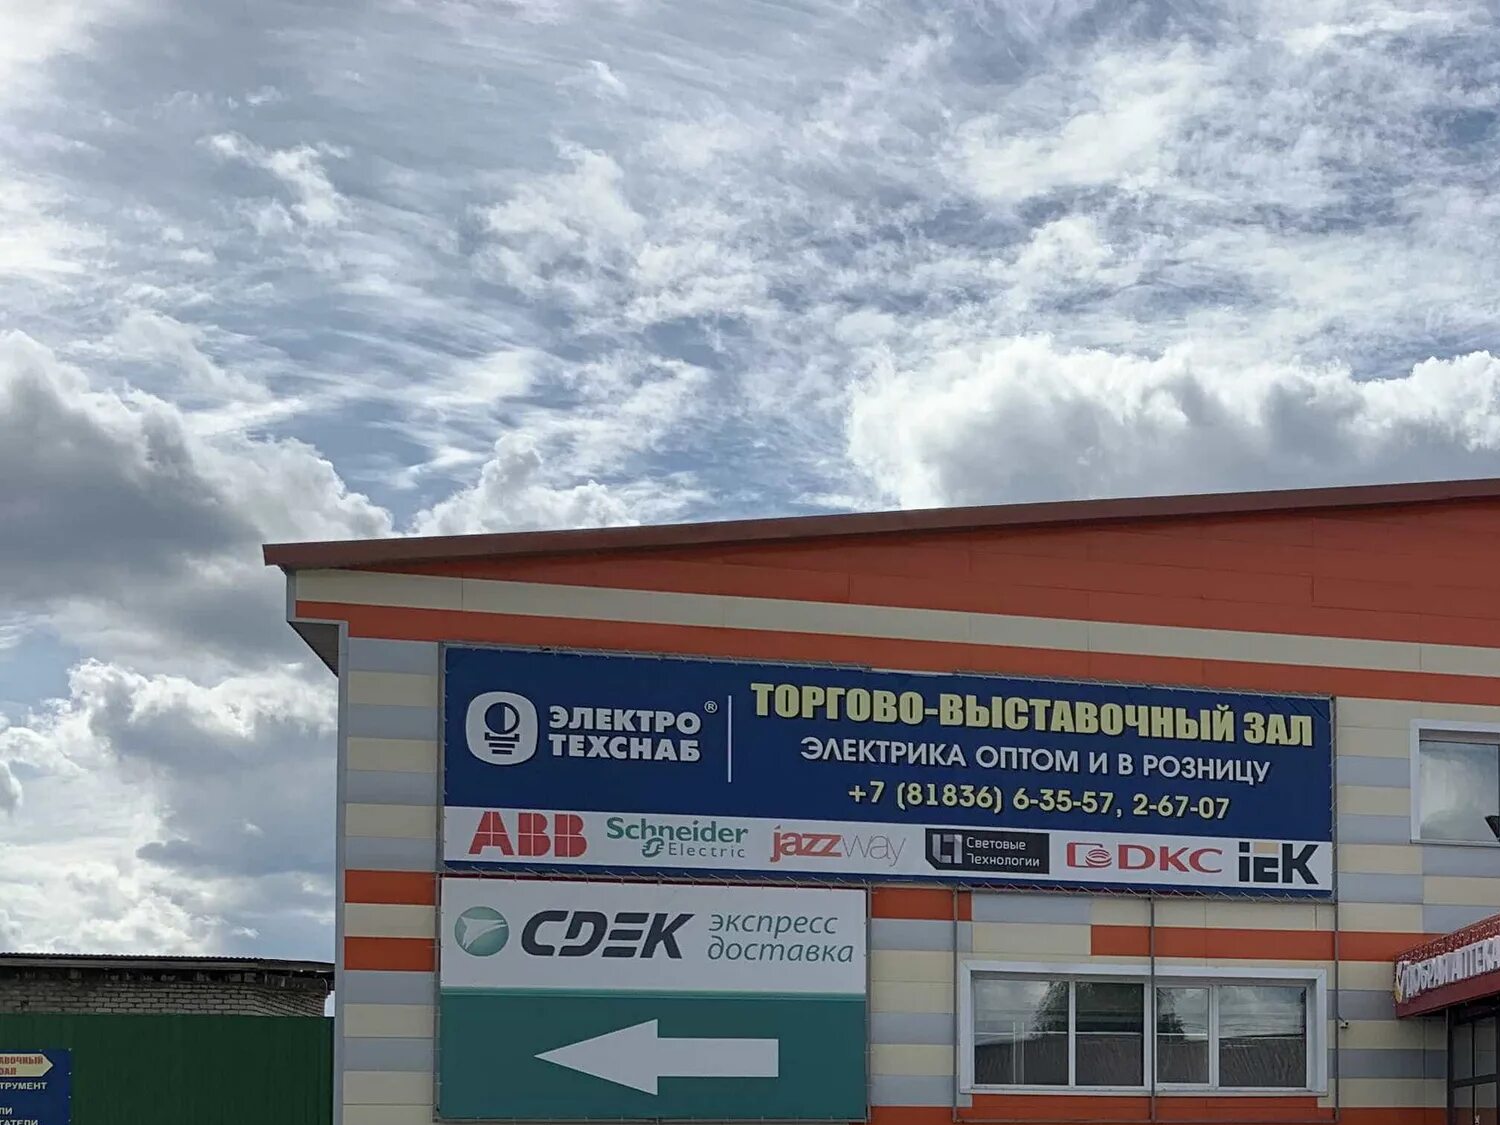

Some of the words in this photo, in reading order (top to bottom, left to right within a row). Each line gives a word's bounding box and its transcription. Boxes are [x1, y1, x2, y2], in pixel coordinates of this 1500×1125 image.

[549, 705, 702, 735] ЭЛЕКТРО
[751, 683, 1236, 742] ТОРГОВО-ВЫСТАВОЧНЫЙ
[1243, 712, 1314, 747] ЗАЛ
[548, 733, 701, 762] ТЕХСНАБ
[800, 736, 968, 767] ЭЛЕКТРИКА
[975, 745, 1079, 773] ОПТОМ
[1088, 752, 1109, 775] И
[1117, 753, 1134, 776] В
[1143, 754, 1271, 786] РОЗНИЦУ
[848, 780, 885, 803] +7
[896, 782, 1002, 814] (81836)
[1012, 787, 1123, 818] 6-35-57,
[1132, 793, 1230, 819] 2-67-07
[468, 811, 588, 858] ABB
[606, 816, 749, 844] Schneider
[966, 836, 1027, 852] Световые
[668, 842, 745, 859] Electric
[769, 825, 906, 868] jazzway
[966, 853, 1041, 869] Технологии
[1117, 843, 1223, 874] DKC
[520, 909, 695, 960] CDEK
[708, 913, 839, 939] экспресс
[707, 935, 855, 963] доставка
